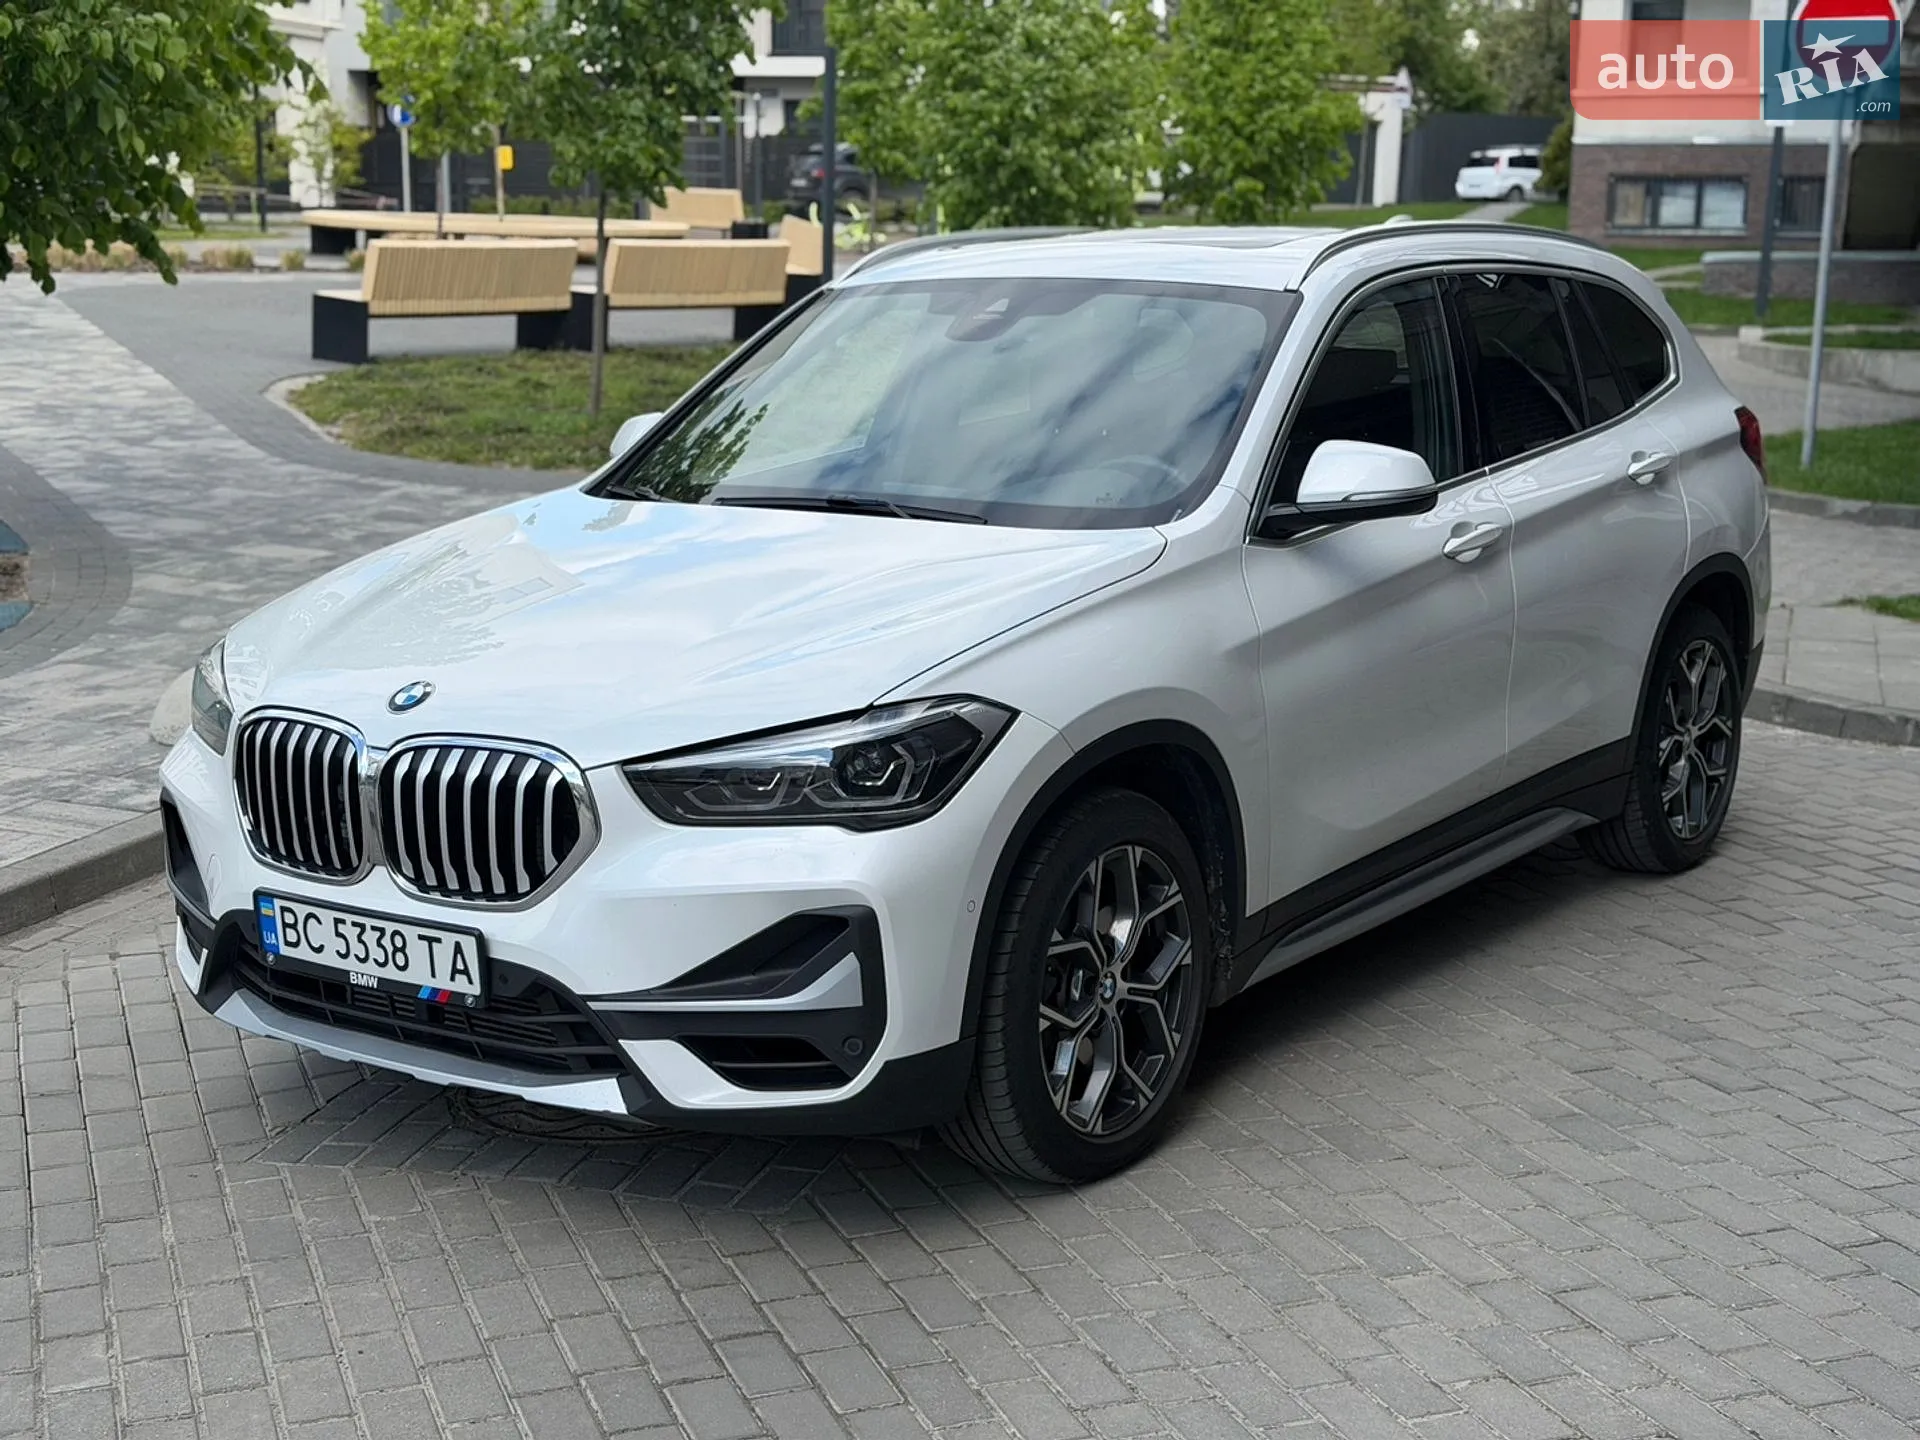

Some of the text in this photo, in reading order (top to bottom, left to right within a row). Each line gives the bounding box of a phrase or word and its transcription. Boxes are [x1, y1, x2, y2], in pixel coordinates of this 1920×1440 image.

[263, 931, 278, 945] UA
[279, 905, 473, 986] BC 5338 TA
[349, 972, 378, 989] BMW
